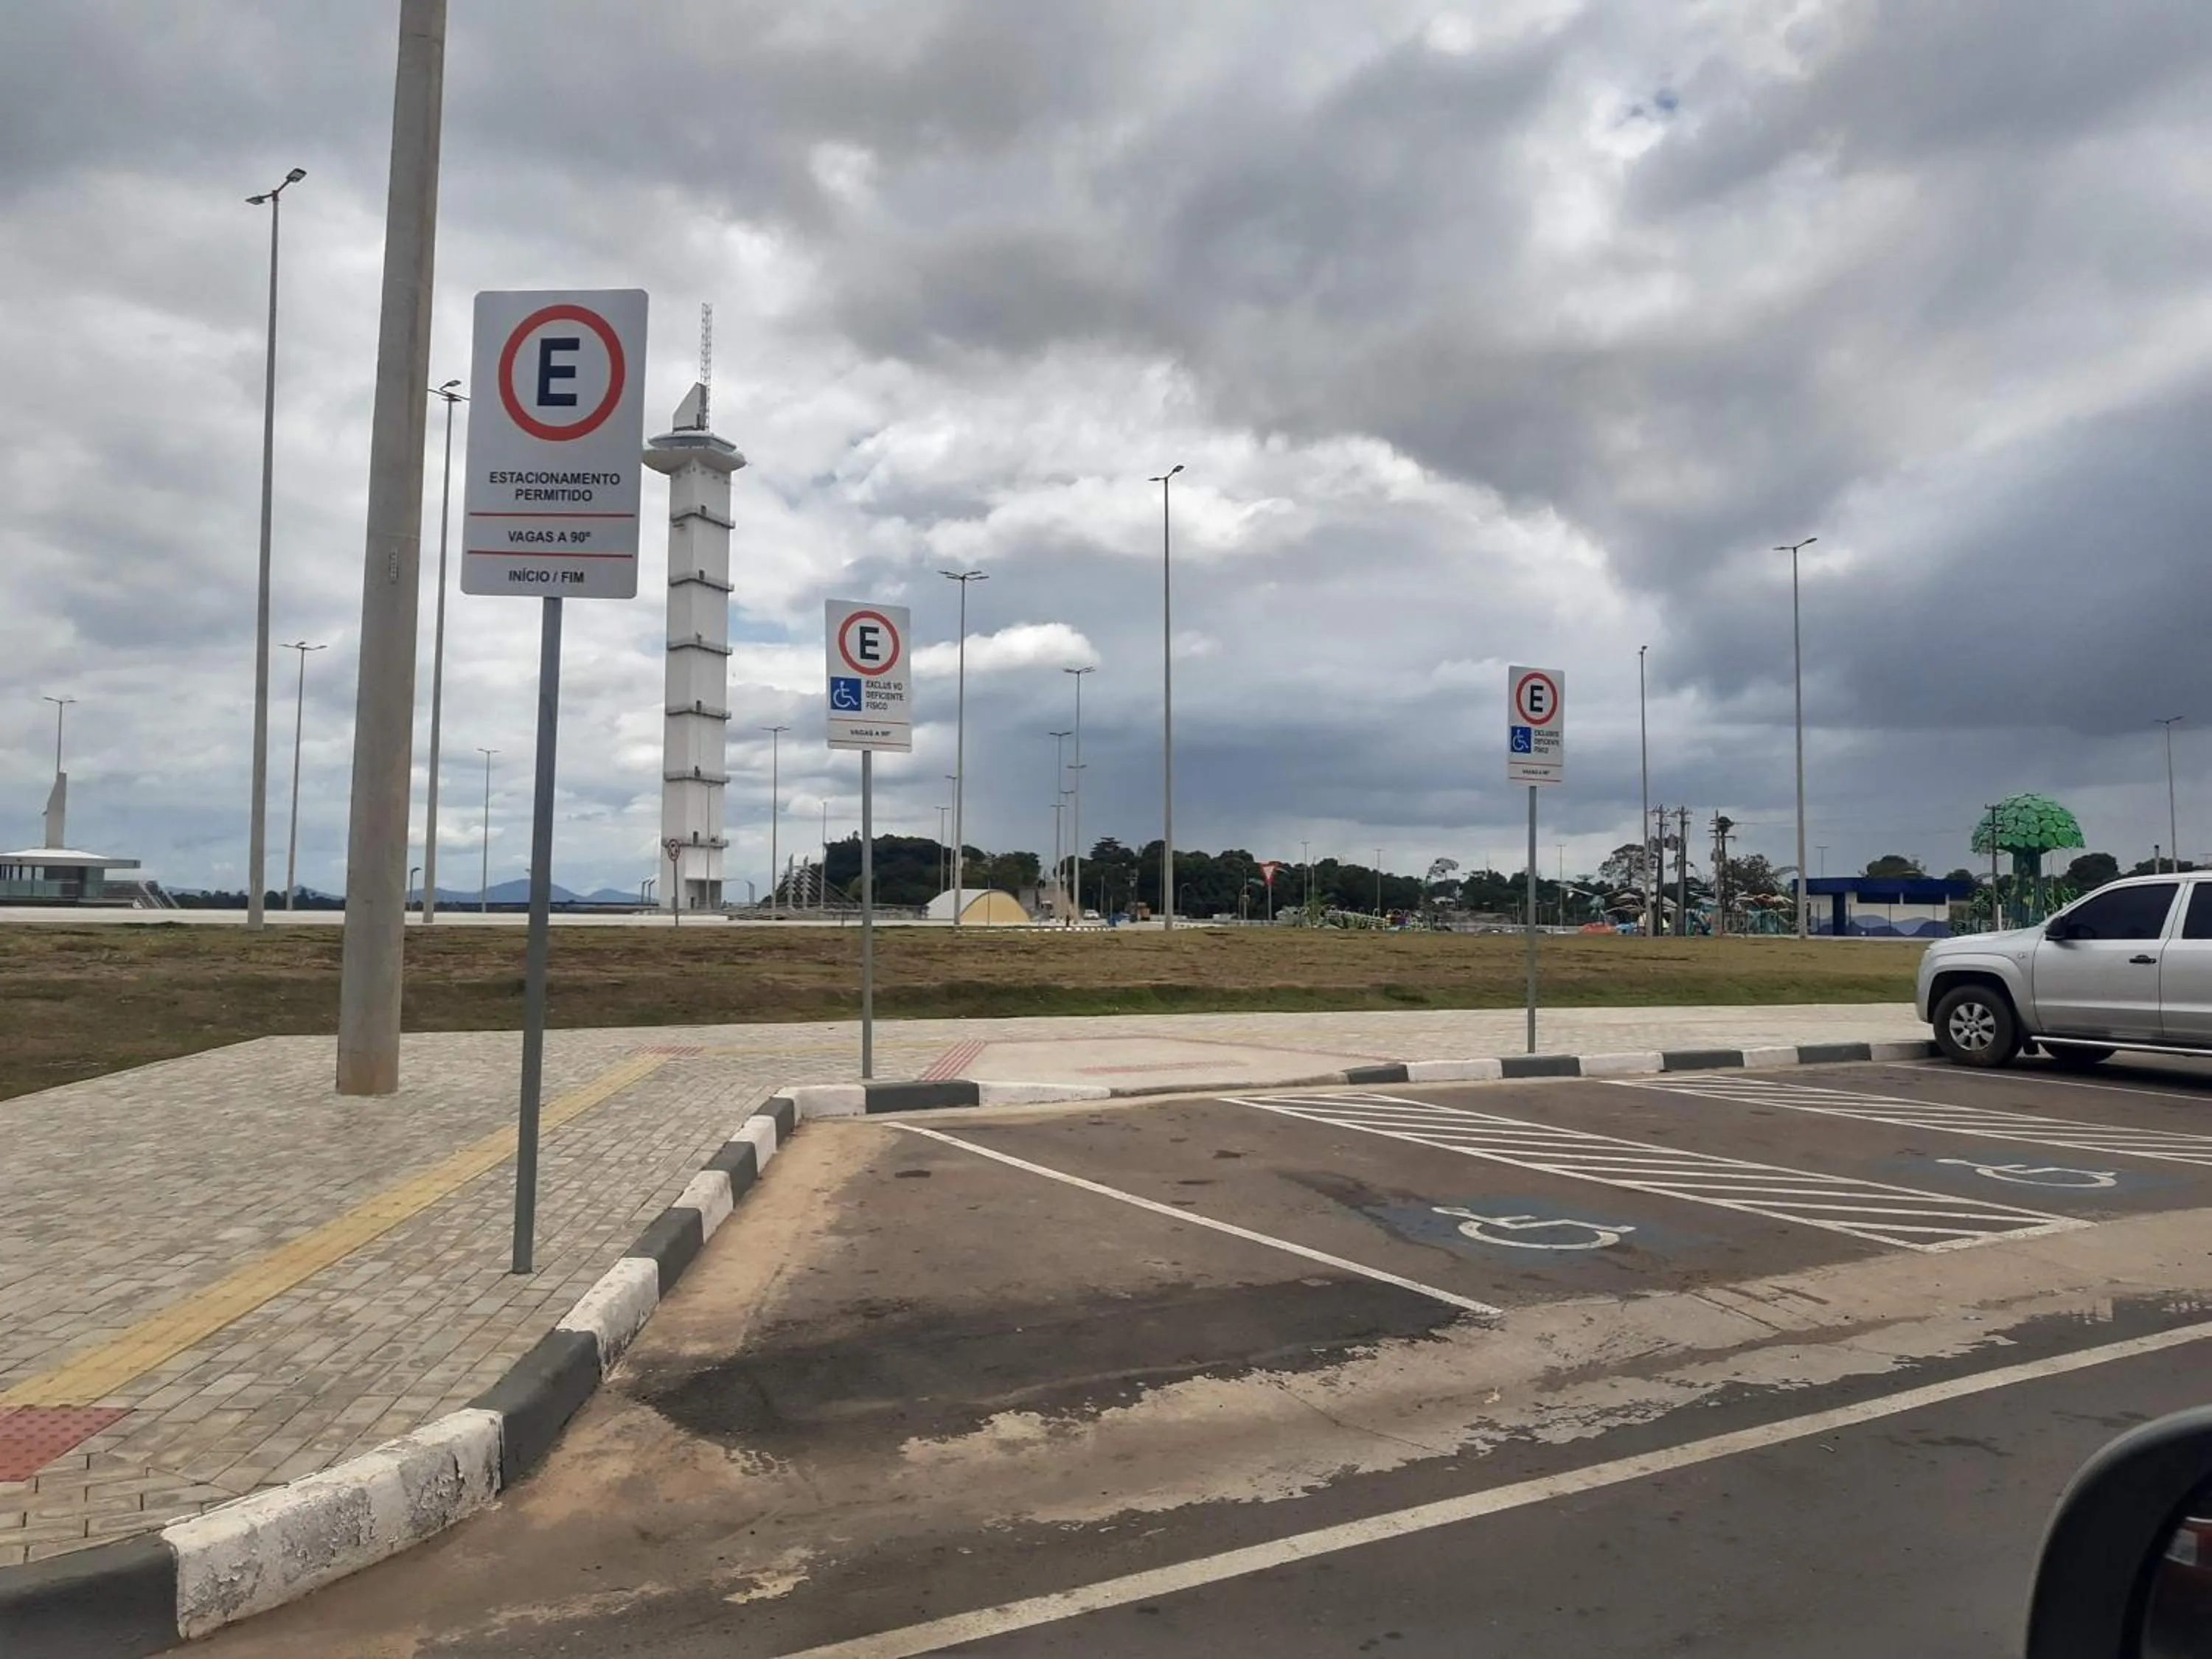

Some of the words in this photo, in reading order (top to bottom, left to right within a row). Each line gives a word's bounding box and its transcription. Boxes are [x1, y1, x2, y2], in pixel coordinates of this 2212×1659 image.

[537, 337, 580, 406] E
[489, 471, 621, 485] ESTACIONAMENTO
[515, 489, 593, 501] PERMITIDO
[508, 530, 554, 543] VAGAS
[557, 531, 567, 543] A
[508, 566, 550, 582] INÍCIO
[561, 571, 585, 584] FIM
[860, 625, 880, 661] E
[866, 680, 903, 691] EXCLUSVO
[1530, 684, 1543, 712] E
